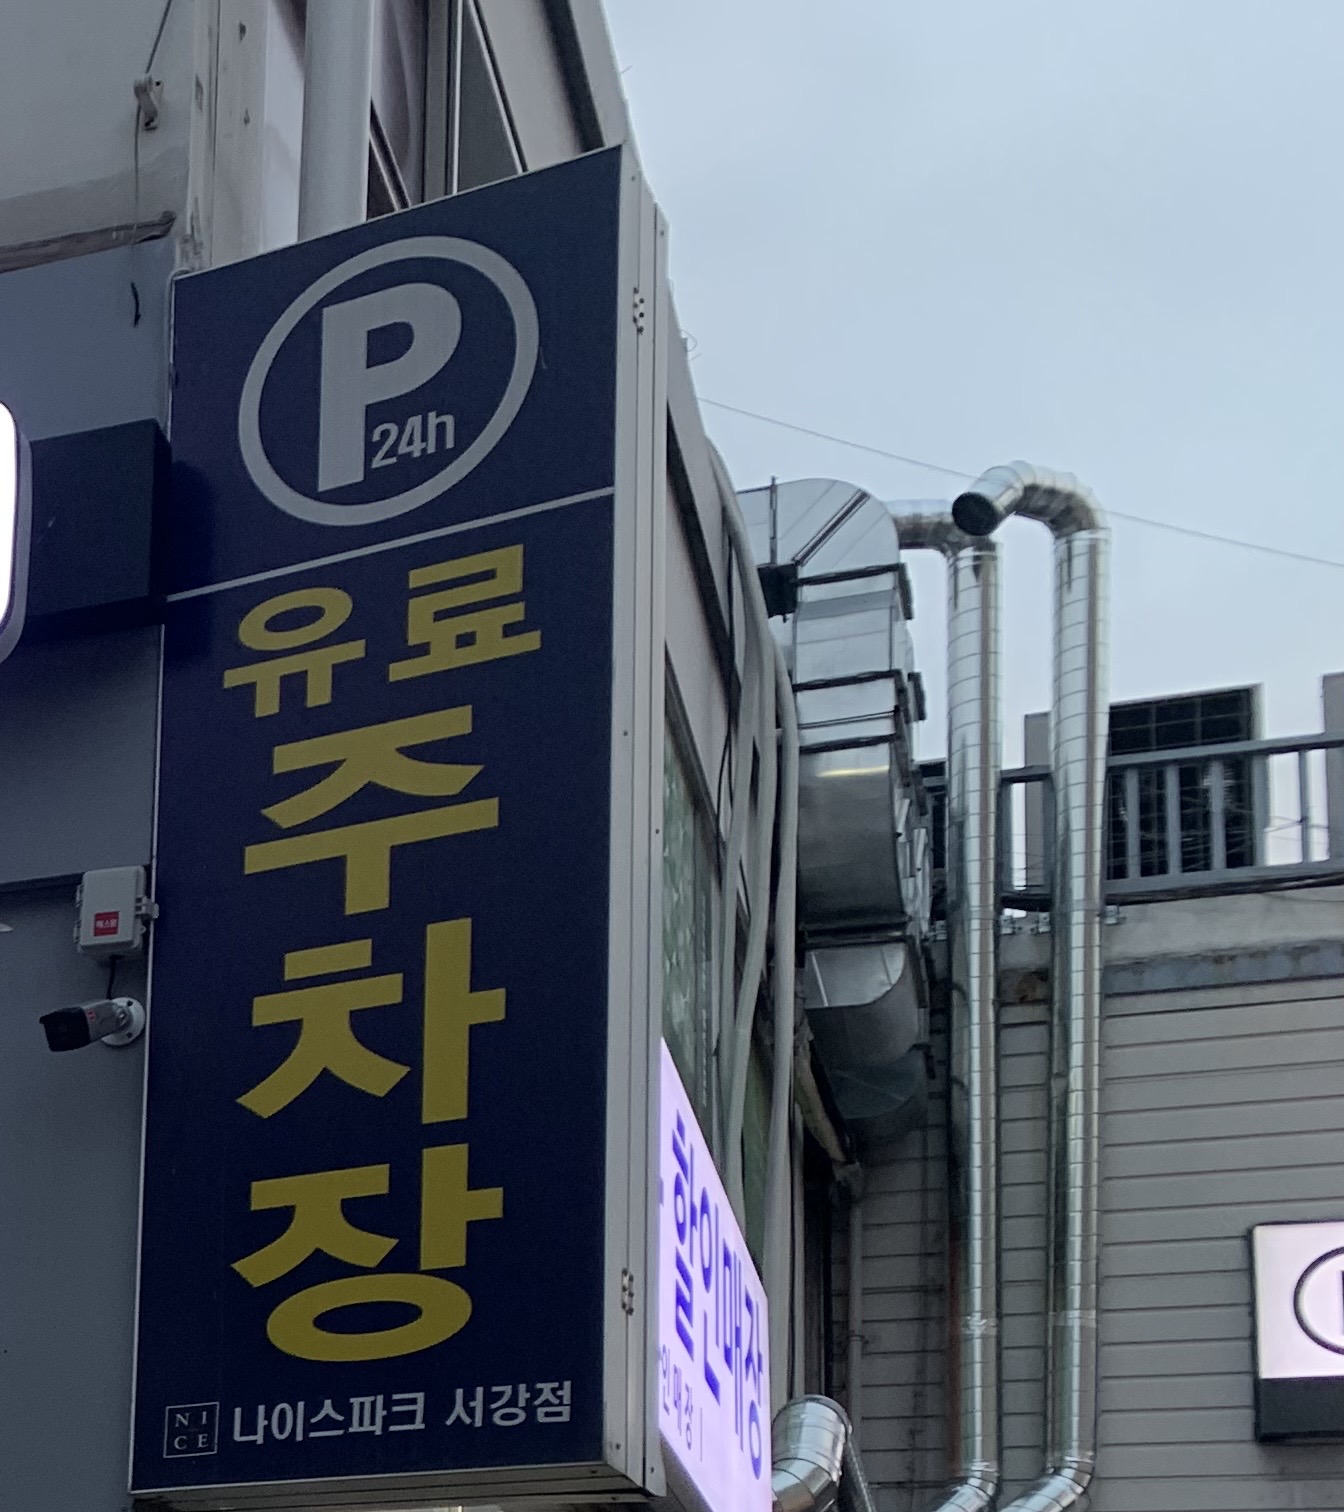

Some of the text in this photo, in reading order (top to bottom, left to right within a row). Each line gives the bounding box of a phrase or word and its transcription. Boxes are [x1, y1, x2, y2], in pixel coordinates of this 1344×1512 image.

[370, 410, 456, 470] 24h
[223, 543, 542, 718] 유료
[230, 703, 507, 1362] 주차장
[671, 1108, 764, 1481] 할인매장
[232, 1379, 572, 1445] 나이스파크 서강점
